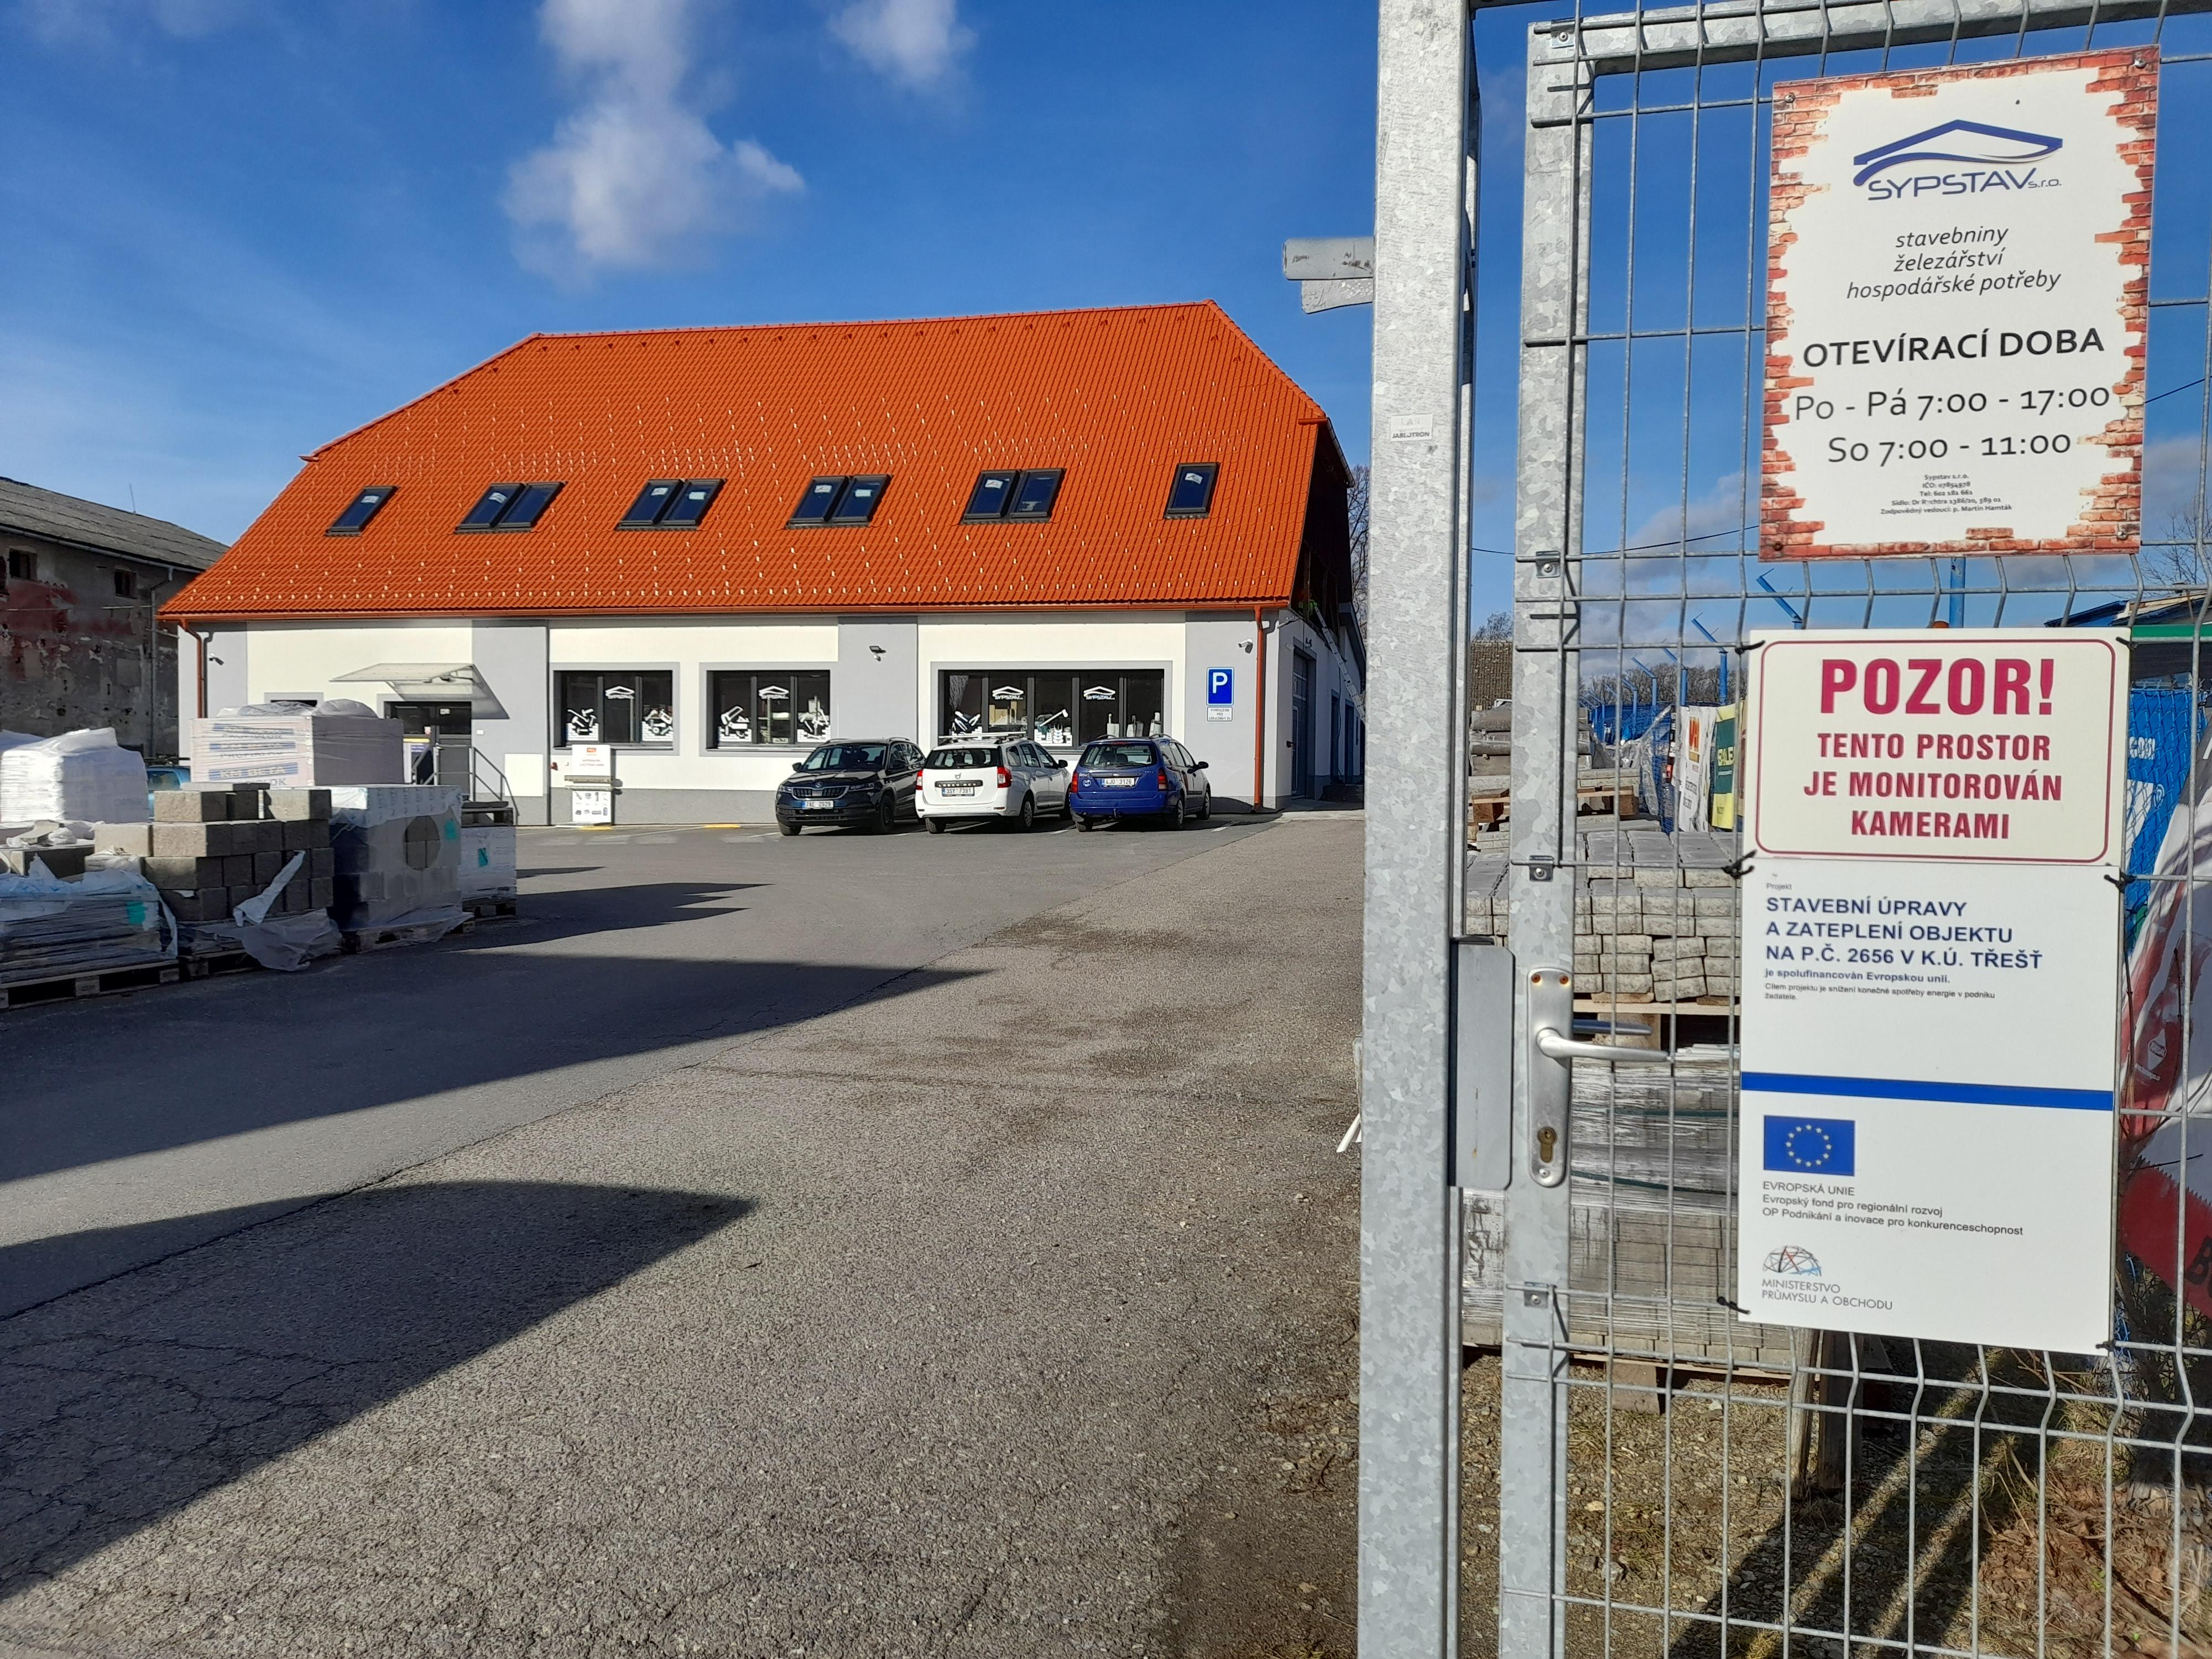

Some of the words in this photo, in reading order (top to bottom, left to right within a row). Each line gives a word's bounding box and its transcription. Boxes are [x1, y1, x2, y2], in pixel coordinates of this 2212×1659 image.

[1868, 168, 2037, 200] SYPSTAV
[2028, 179, 2062, 188] s.r.o.
[1896, 226, 2008, 247] stavebniny
[1893, 247, 2005, 272] železářství
[1847, 275, 1975, 301] hospodářské
[1979, 269, 2061, 295] potřeby
[1804, 328, 1989, 367] OTEVÍRACÍ
[2000, 328, 2104, 356] DOBA
[1797, 396, 1834, 420] Po
[1869, 388, 1906, 416] Pá
[1918, 393, 1986, 420] 7:00
[2021, 388, 2109, 415] 17:00
[1829, 437, 1869, 462] So
[1879, 440, 1948, 467] 7:00
[1982, 435, 2070, 456] 11:00
[1212, 672, 1228, 694] P
[1821, 658, 2054, 715] POZOR!
[1818, 733, 1904, 758] TENTO
[1917, 734, 2050, 760] PROSTOR
[1804, 771, 1837, 796] JE
[1849, 769, 2062, 801] MONITOROVÁN
[1852, 810, 2008, 839] KAMERAMI
[1767, 883, 1792, 891] Projekt
[1767, 896, 1870, 914] STAVEBNÍ
[1879, 896, 1966, 916] ÚPRAVY
[1766, 921, 1780, 935] A
[1786, 921, 1902, 939] ZATEPLENÍ
[1910, 926, 2012, 942] OBJEKTU
[1767, 946, 1794, 960] NA
[1802, 943, 1840, 962] P.Č.
[1848, 948, 1893, 963] 2656
[1901, 950, 1914, 964] V
[1922, 947, 1963, 966] K.Ú.
[1971, 949, 2042, 968] TŘEŠŤ
[1765, 969, 1774, 978] je
[1777, 970, 1863, 979] spolufinancován
[1867, 972, 1923, 983] Evropskou
[1789, 984, 1818, 993] projektu
[1764, 1181, 1825, 1193] EVROPSKÁ
[1828, 1186, 1854, 1196] UNIE
[1763, 1194, 1809, 1208] Evropský
[1812, 1198, 1834, 1207] fond
[1838, 1202, 1854, 1210] pro
[1857, 1201, 1908, 1214] regionální
[1912, 1206, 1943, 1218] rozvoj
[1762, 1207, 1778, 1216] OP
[1782, 1209, 1832, 1220] Podnikání
[1845, 1214, 1884, 1225] inovace
[1888, 1219, 1905, 1227] pro
[1908, 1219, 2023, 1235] konkurenceschopnost
[1762, 1279, 1840, 1293] MINISTERSTVO
[1762, 1288, 1817, 1304] PRŮMYSLU
[1833, 1296, 1892, 1310] OBCHODU
